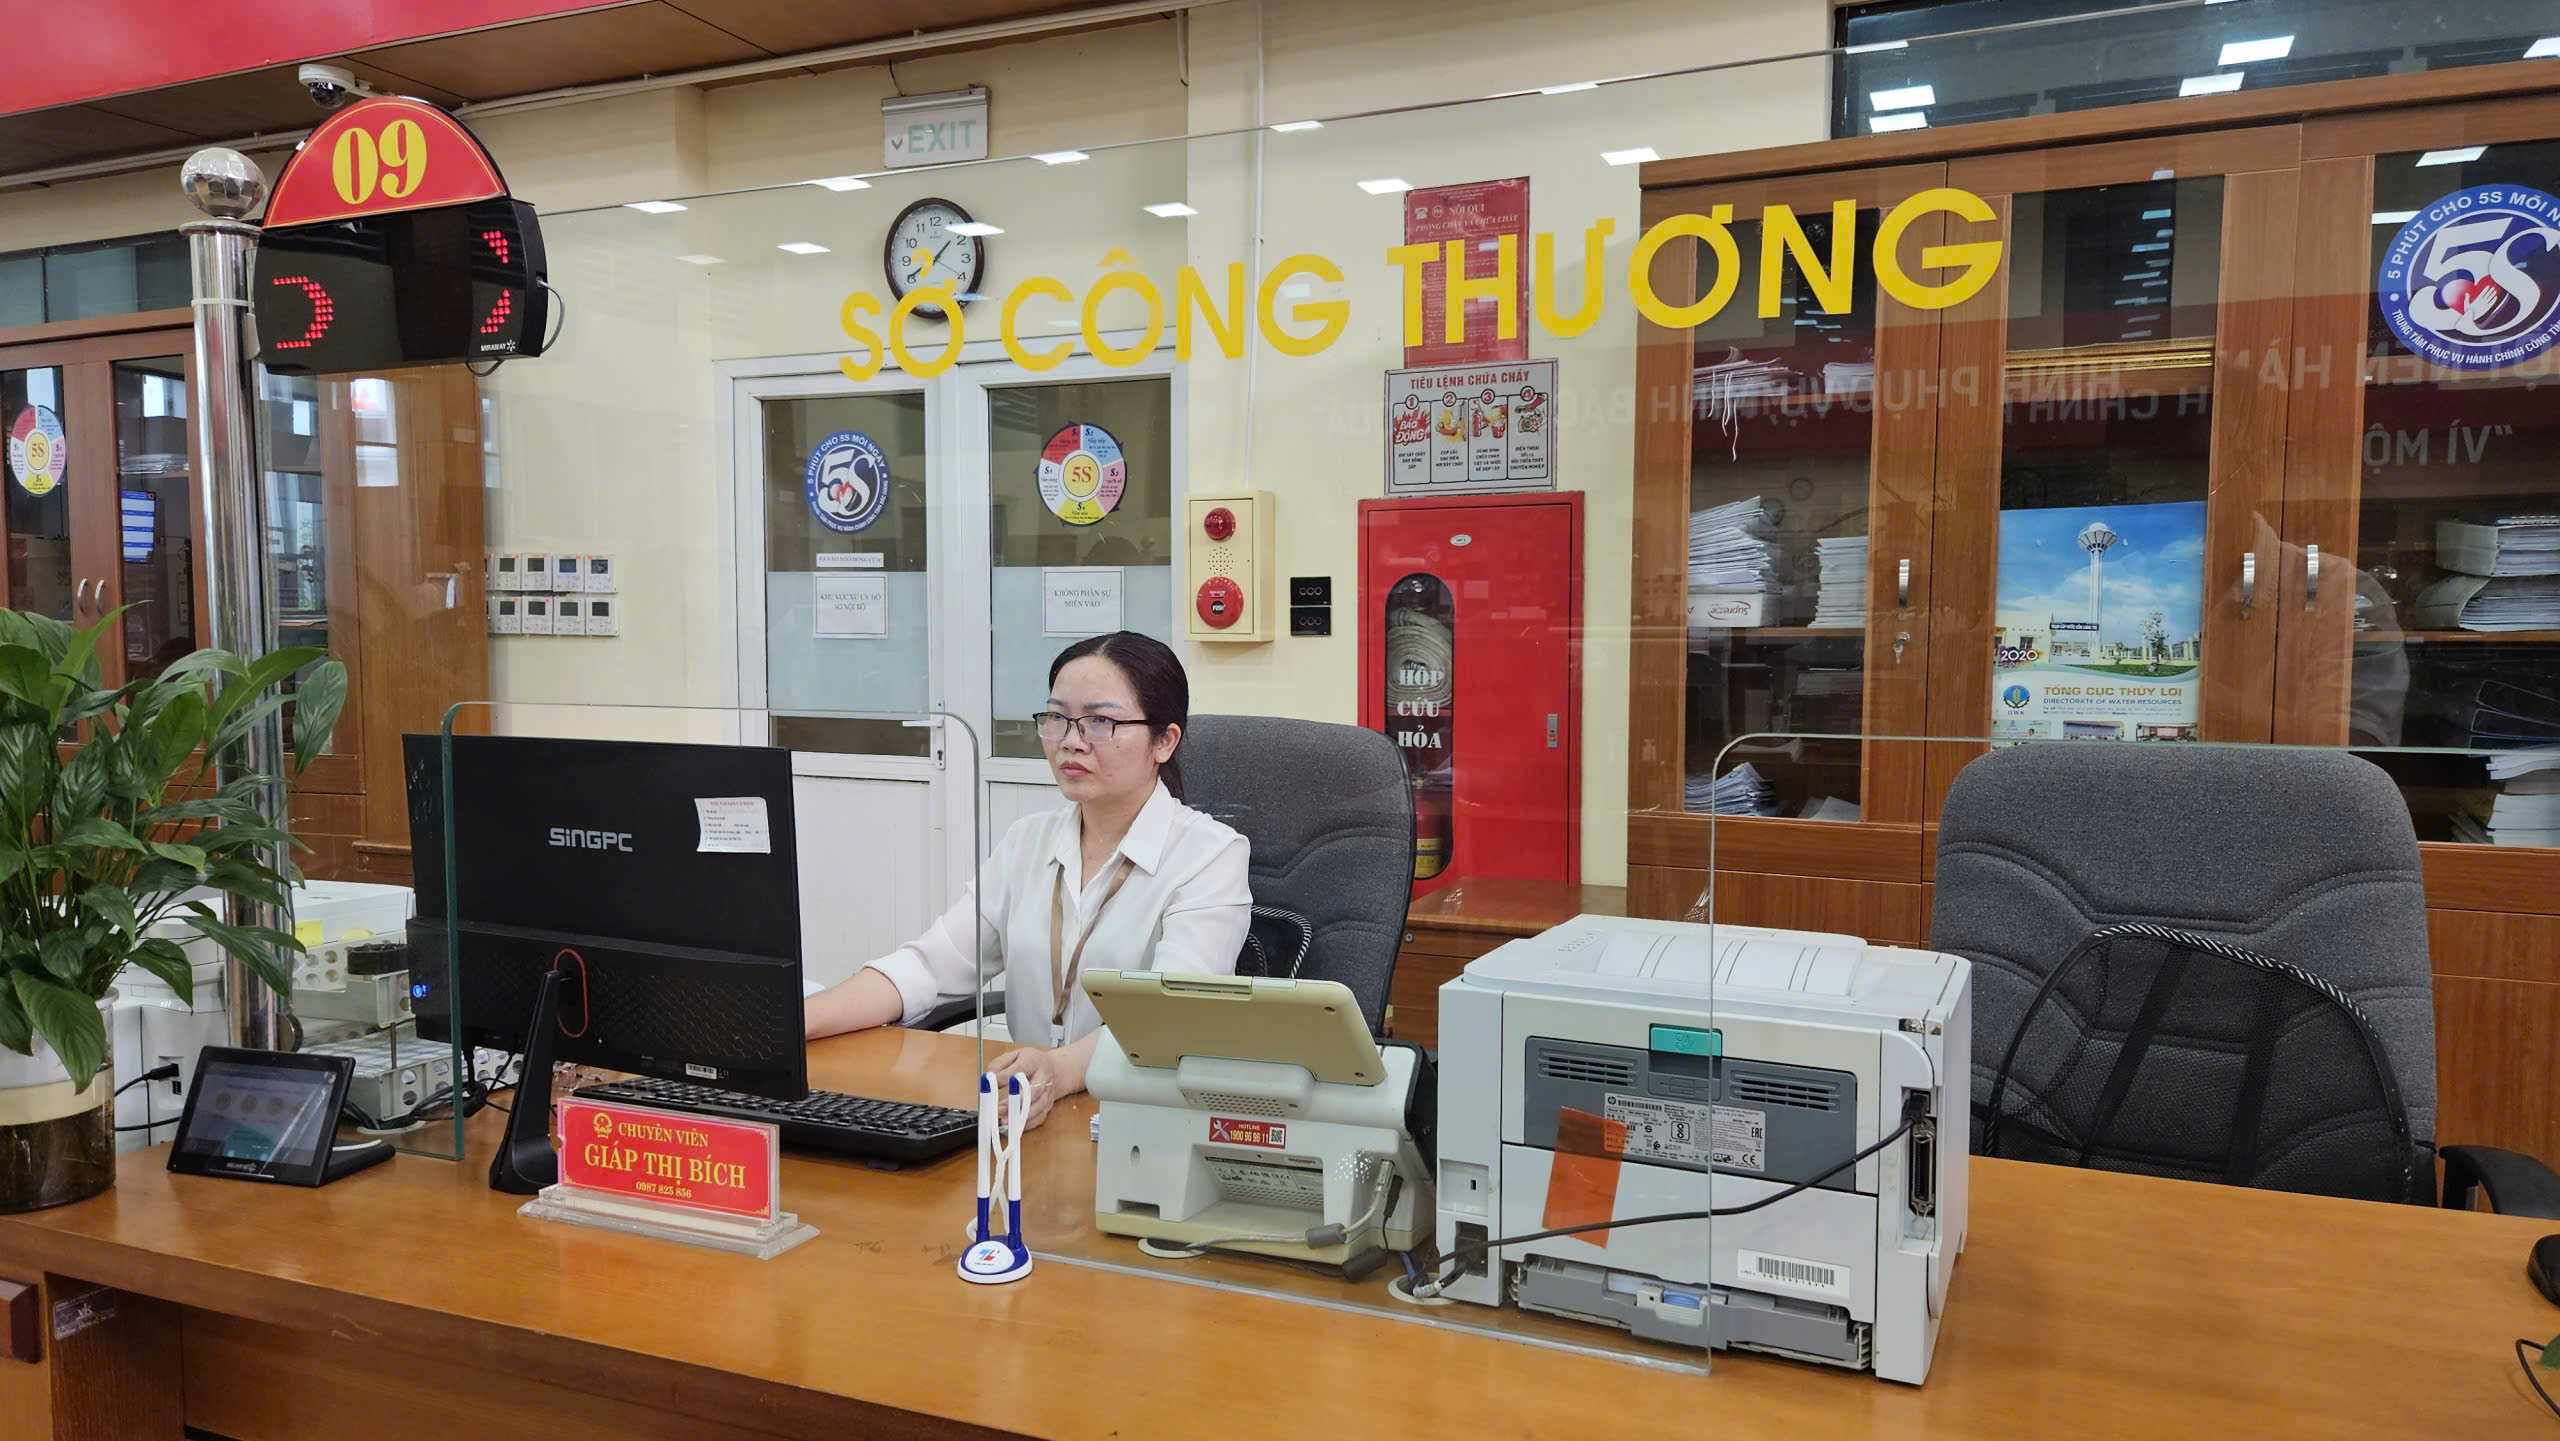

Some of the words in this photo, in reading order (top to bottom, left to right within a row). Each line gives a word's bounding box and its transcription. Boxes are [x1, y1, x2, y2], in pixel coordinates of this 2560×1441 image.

[907, 119, 977, 153] EXIT
[332, 119, 427, 205] 09
[2479, 191, 2503, 204] 5S
[2508, 191, 2548, 213] MỖI
[2429, 196, 2472, 222] CHO
[916, 223, 925, 232] 11
[929, 216, 941, 227] 12
[906, 238, 917, 249] 10
[2391, 220, 2427, 265] PHÚT
[902, 256, 911, 266] 9
[961, 253, 971, 264] 3
[2387, 270, 2401, 279] 5
[838, 247, 965, 383] SỞ
[1000, 247, 1351, 372] CÔNG
[1386, 187, 2003, 348] THƯƠNG
[2391, 308, 2411, 336] TRUNG
[2409, 329, 2428, 349] TÂM
[2425, 342, 2450, 360] PHỤC
[2465, 352, 2493, 364] HÀNH
[2494, 346, 2525, 363] CHÍNH
[2525, 332, 2552, 352] CÔNG
[1437, 374, 1464, 390] LỆNH
[1468, 371, 1497, 386] CHỮA
[1501, 368, 1530, 384] CHÁY
[1408, 397, 1415, 407] 1
[1445, 394, 1453, 404] 2
[1484, 392, 1492, 402] 3
[1522, 389, 1532, 398] 4
[821, 436, 838, 452] CHO
[840, 434, 850, 442] 5S
[1396, 429, 1425, 446] ĐỘNG
[31, 442, 45, 458] 5S
[1072, 466, 1092, 483] 5S
[2000, 650, 2038, 661] 2020
[1399, 664, 1444, 690] HỘP
[1397, 696, 1440, 718] CỨU
[1397, 724, 1442, 750] HỎA
[618, 1121, 673, 1144] CHUYÊN
[676, 1127, 709, 1148] VIÊN
[1238, 1123, 1261, 1131] HOTLINE
[1230, 1130, 1243, 1141] 1900
[1244, 1131, 1252, 1142] 96
[1252, 1132, 1261, 1143] 96
[1261, 1133, 1269, 1143] 11
[584, 1141, 638, 1172] GIÁP
[643, 1152, 683, 1185] THỊ
[689, 1151, 746, 1188] BÍCH
[635, 1180, 656, 1193] 0987
[658, 1183, 674, 1196] 825
[676, 1186, 692, 1199] 856
